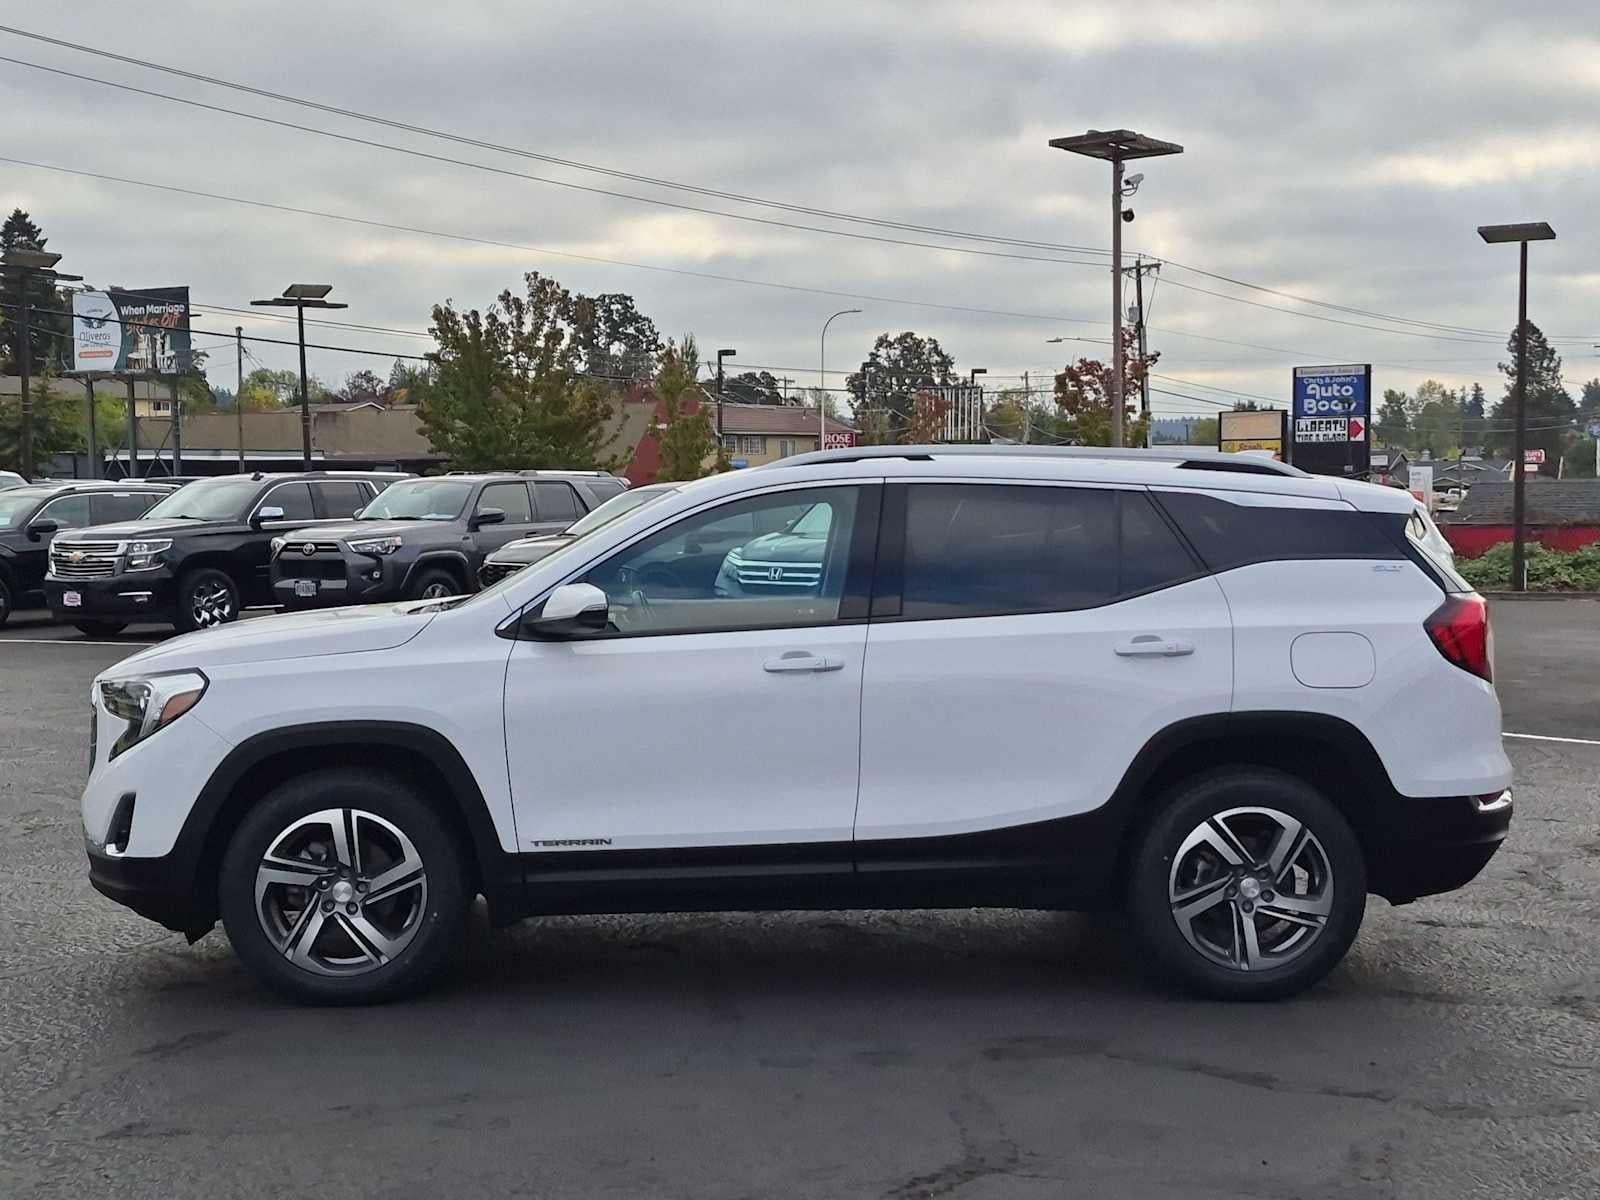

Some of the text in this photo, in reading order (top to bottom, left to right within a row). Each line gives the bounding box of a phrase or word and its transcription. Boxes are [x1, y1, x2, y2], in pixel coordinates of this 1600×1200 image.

[120, 304, 145, 316] When
[1306, 383, 1354, 400] Auto
[824, 433, 852, 444] ROSE
[530, 838, 613, 847] TERRAIN
